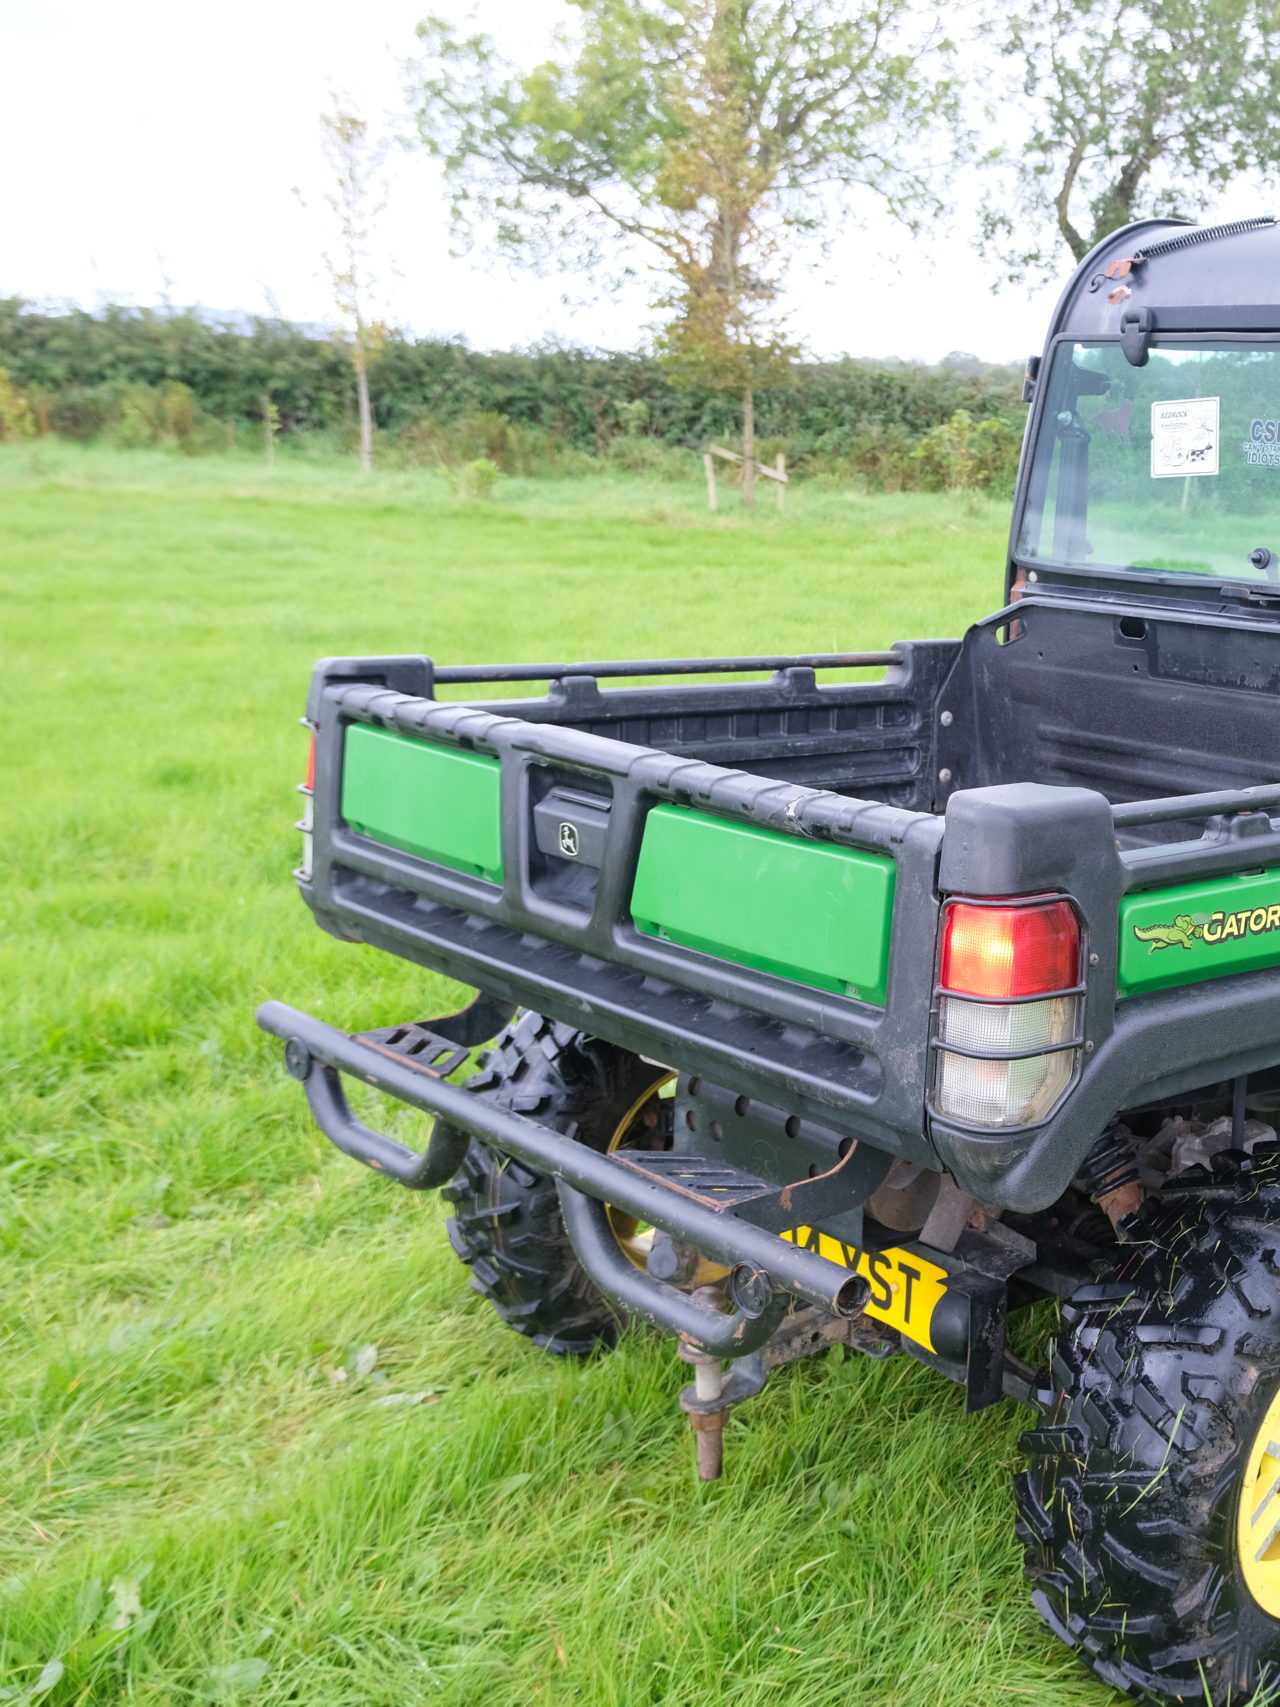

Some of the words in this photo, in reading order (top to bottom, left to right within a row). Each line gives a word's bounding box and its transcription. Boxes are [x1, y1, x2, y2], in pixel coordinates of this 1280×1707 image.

[1160, 411, 1188, 419] REDROCK
[1243, 442, 1264, 453] CAN'T
[1247, 452, 1280, 465] IDIOTS
